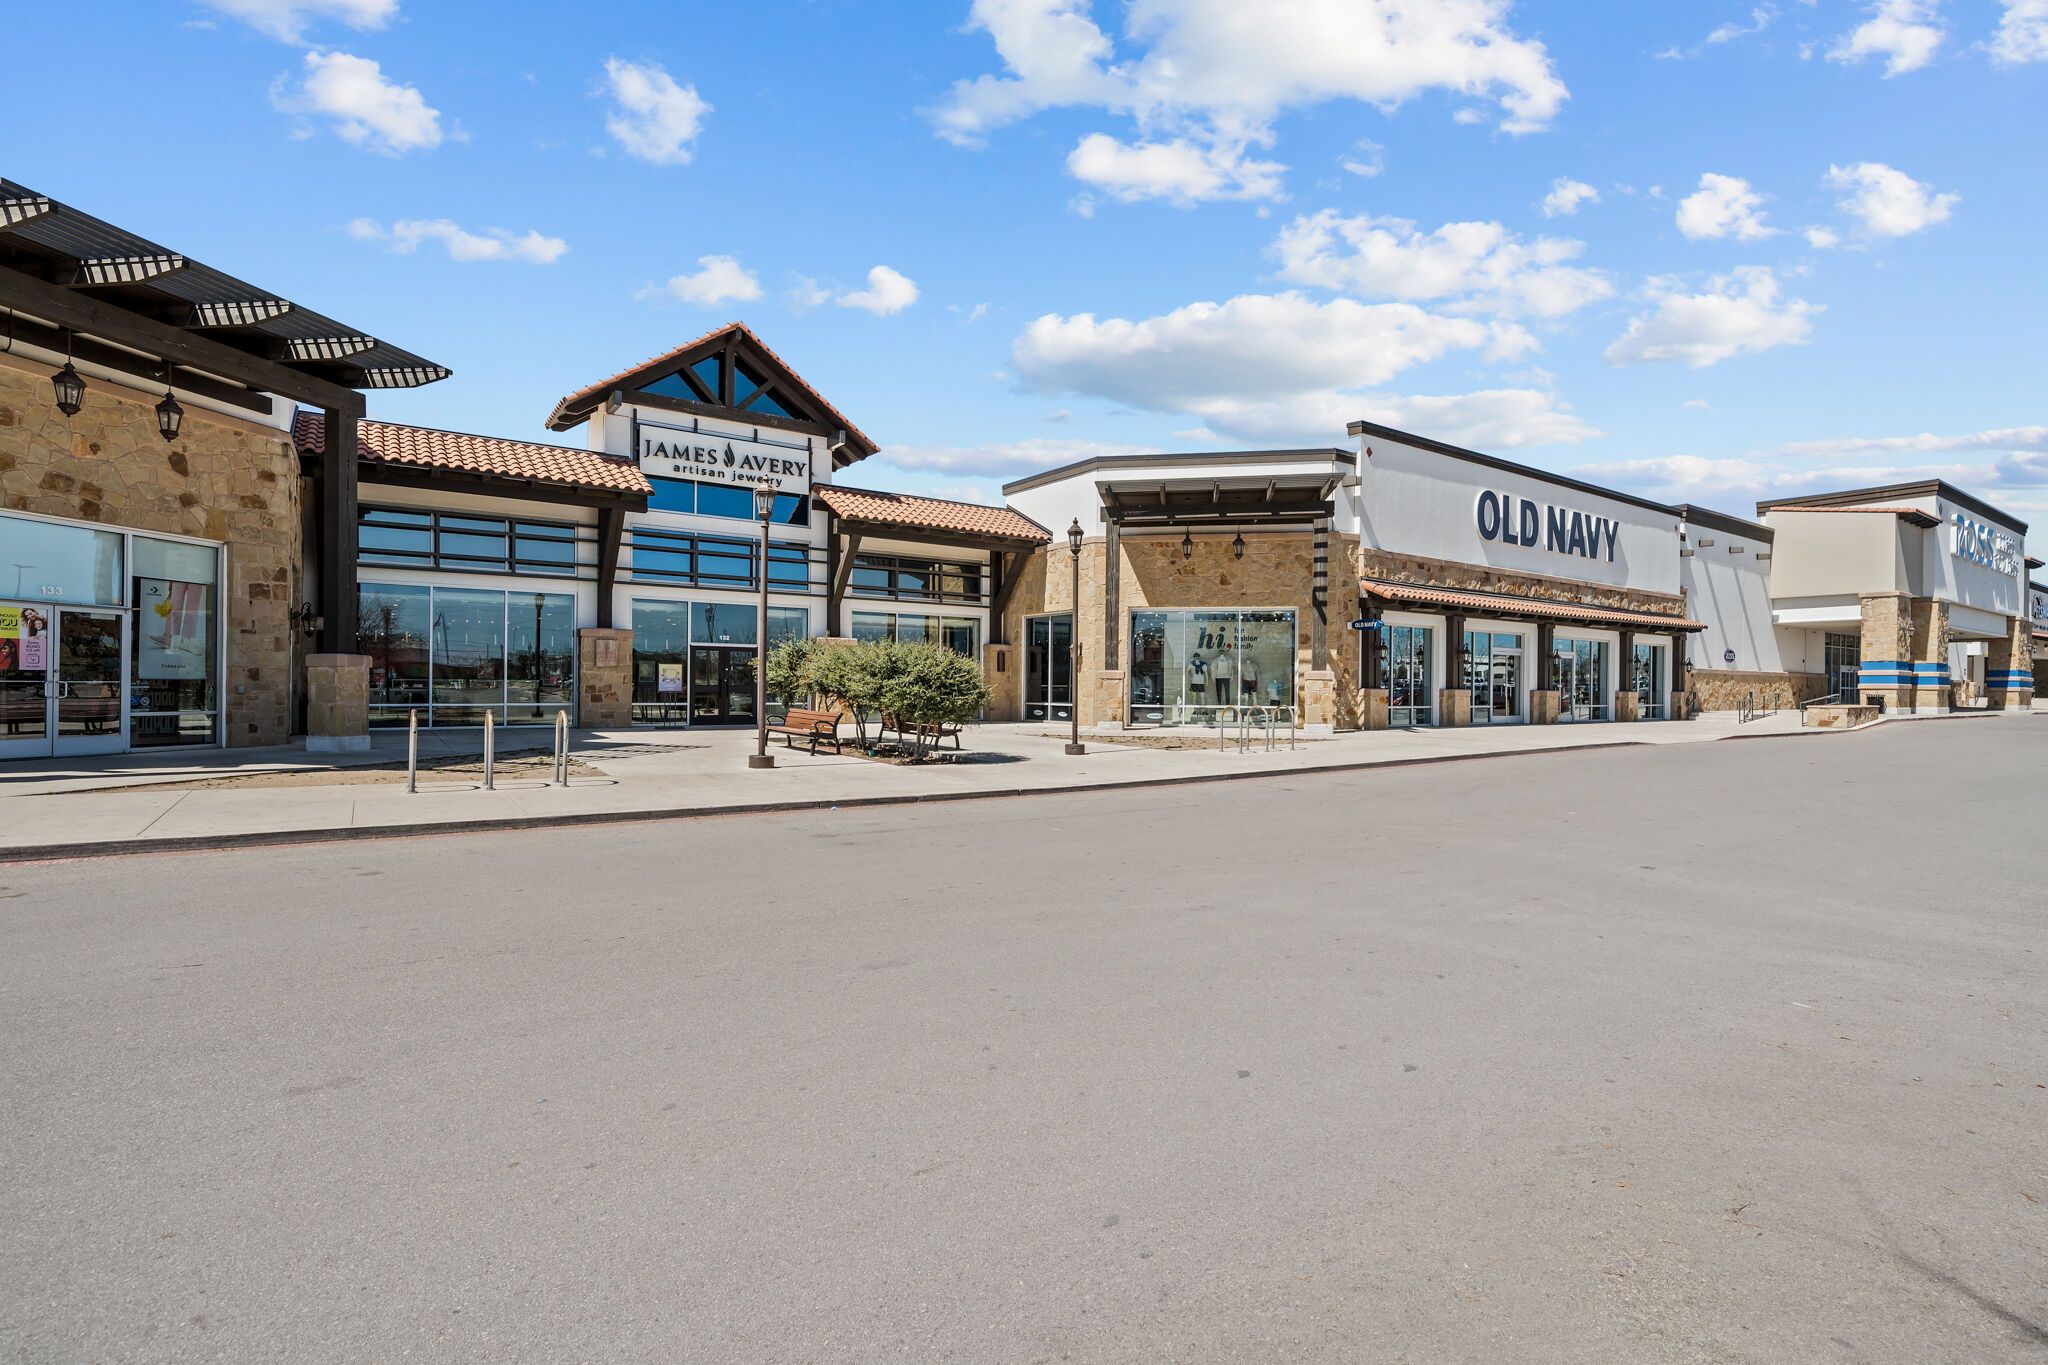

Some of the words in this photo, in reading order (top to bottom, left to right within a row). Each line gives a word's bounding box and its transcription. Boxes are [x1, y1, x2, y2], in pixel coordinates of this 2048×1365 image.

[644, 440, 718, 465] JAMES
[739, 454, 807, 477] AVERY
[673, 463, 725, 479] artisan
[731, 470, 783, 488] jewery
[1476, 489, 1540, 548] OLD
[1544, 504, 1620, 563] NAVY
[1951, 513, 1995, 569] ROSS
[41, 586, 63, 595] 133
